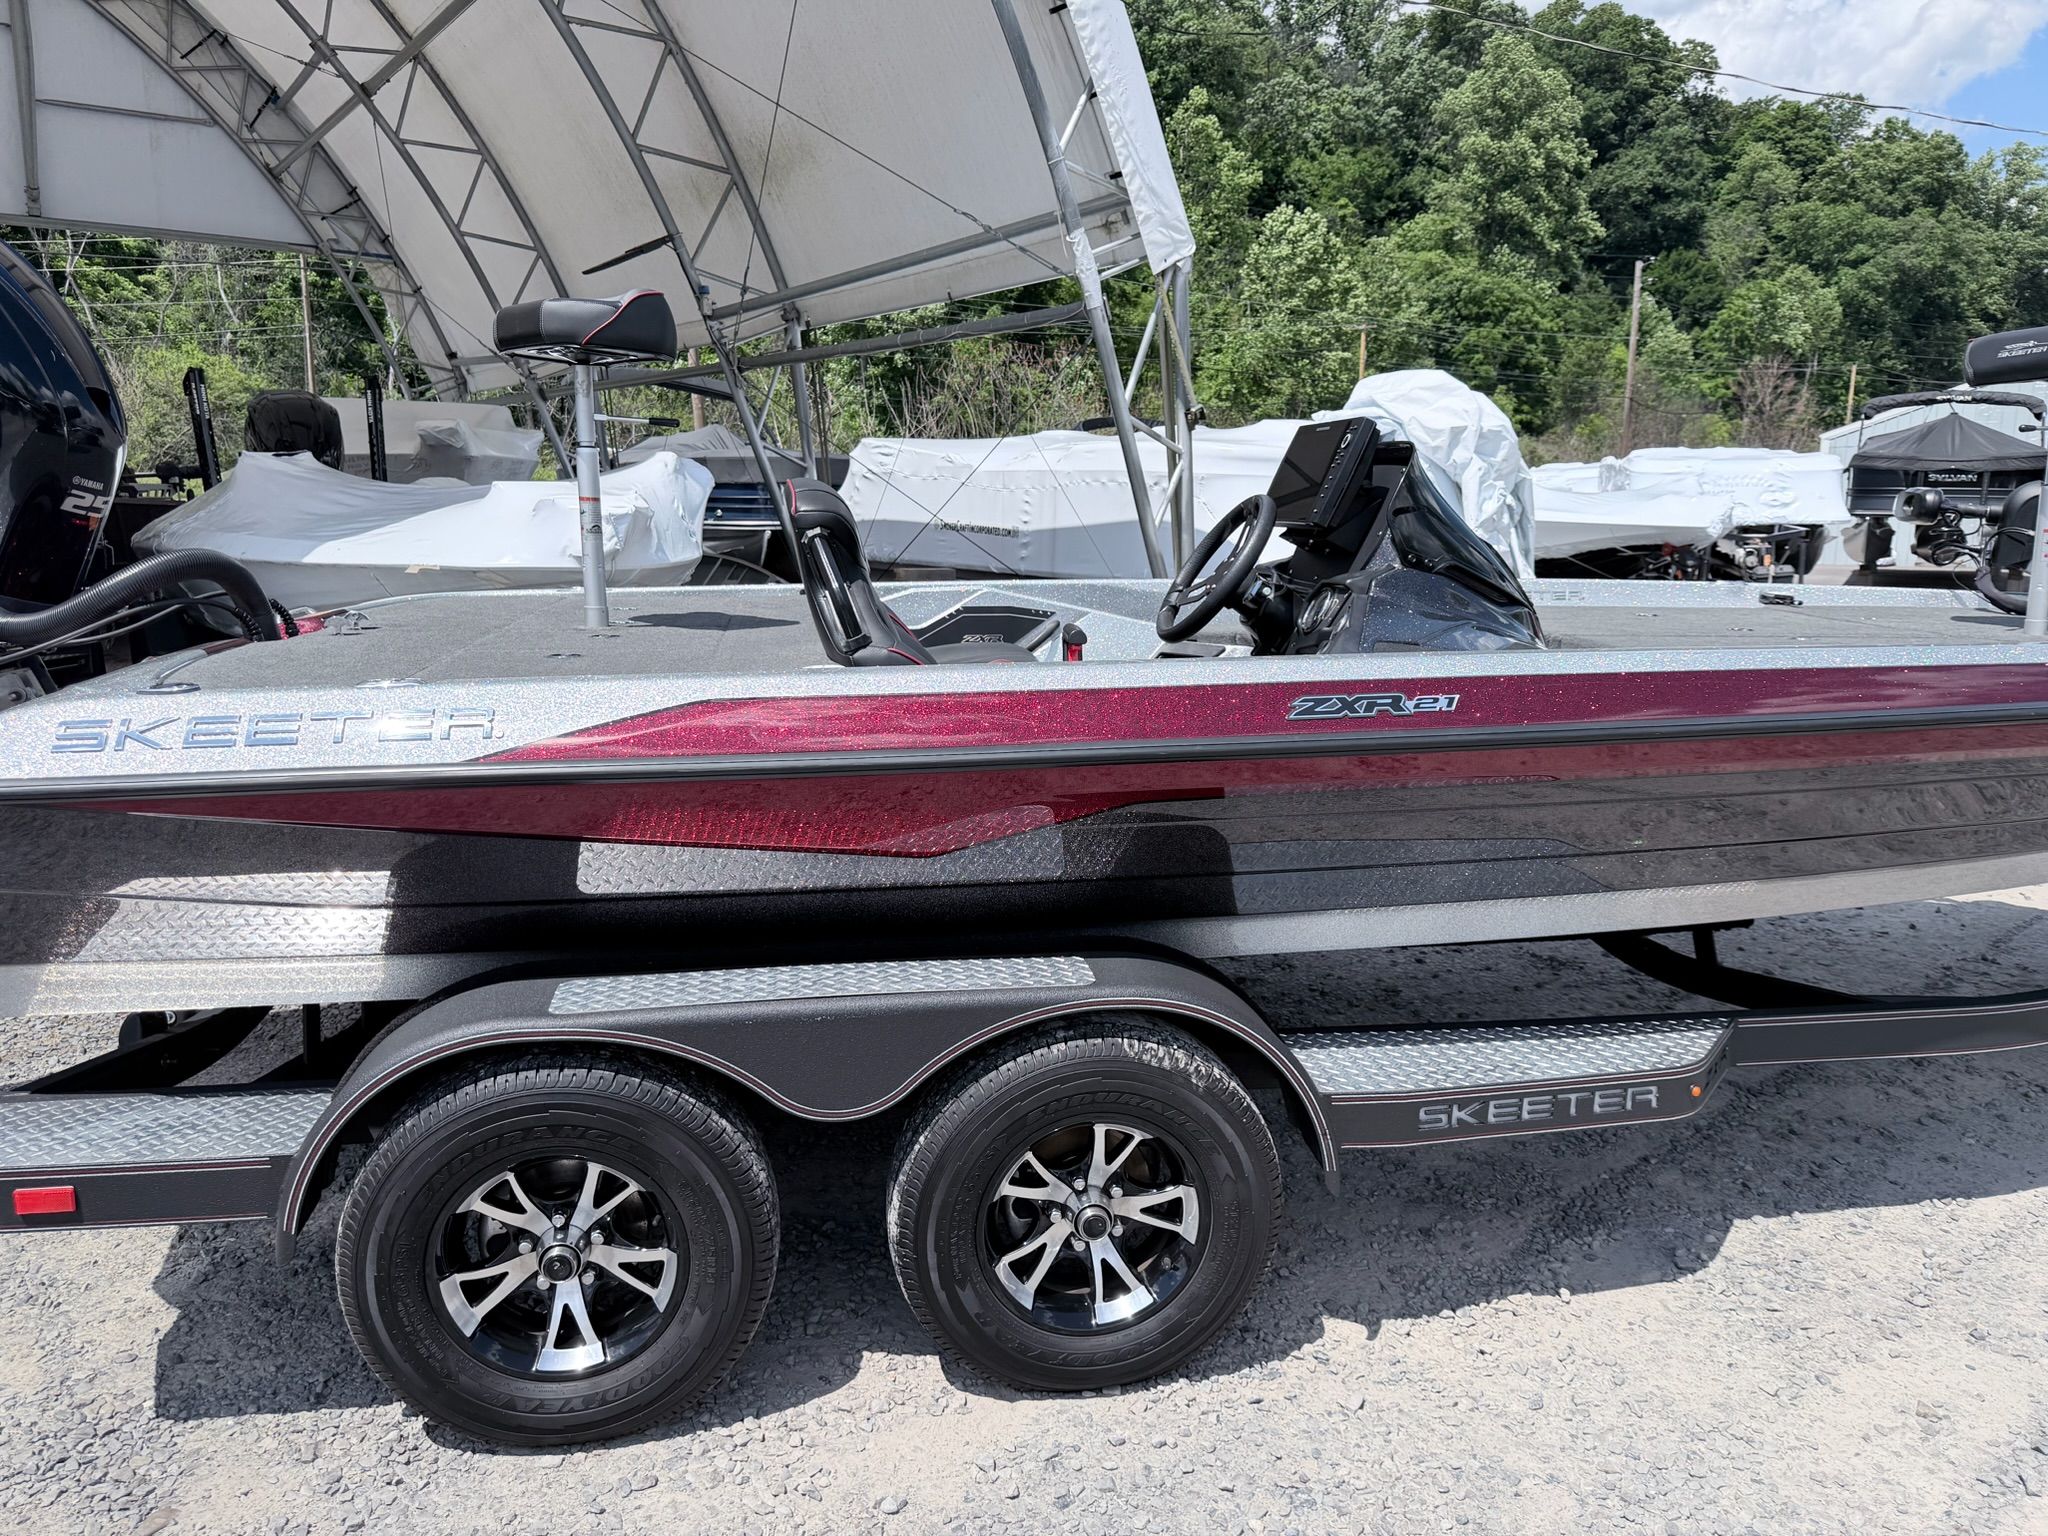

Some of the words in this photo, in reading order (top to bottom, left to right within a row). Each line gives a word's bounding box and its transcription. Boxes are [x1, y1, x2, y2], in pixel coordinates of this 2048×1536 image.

[202, 402, 210, 420] KOTA
[80, 478, 104, 490] YAMAHA
[1928, 473, 1978, 482] SYLVAN
[51, 706, 498, 753] SKEETER
[1417, 1085, 1659, 1132] SKEETER
